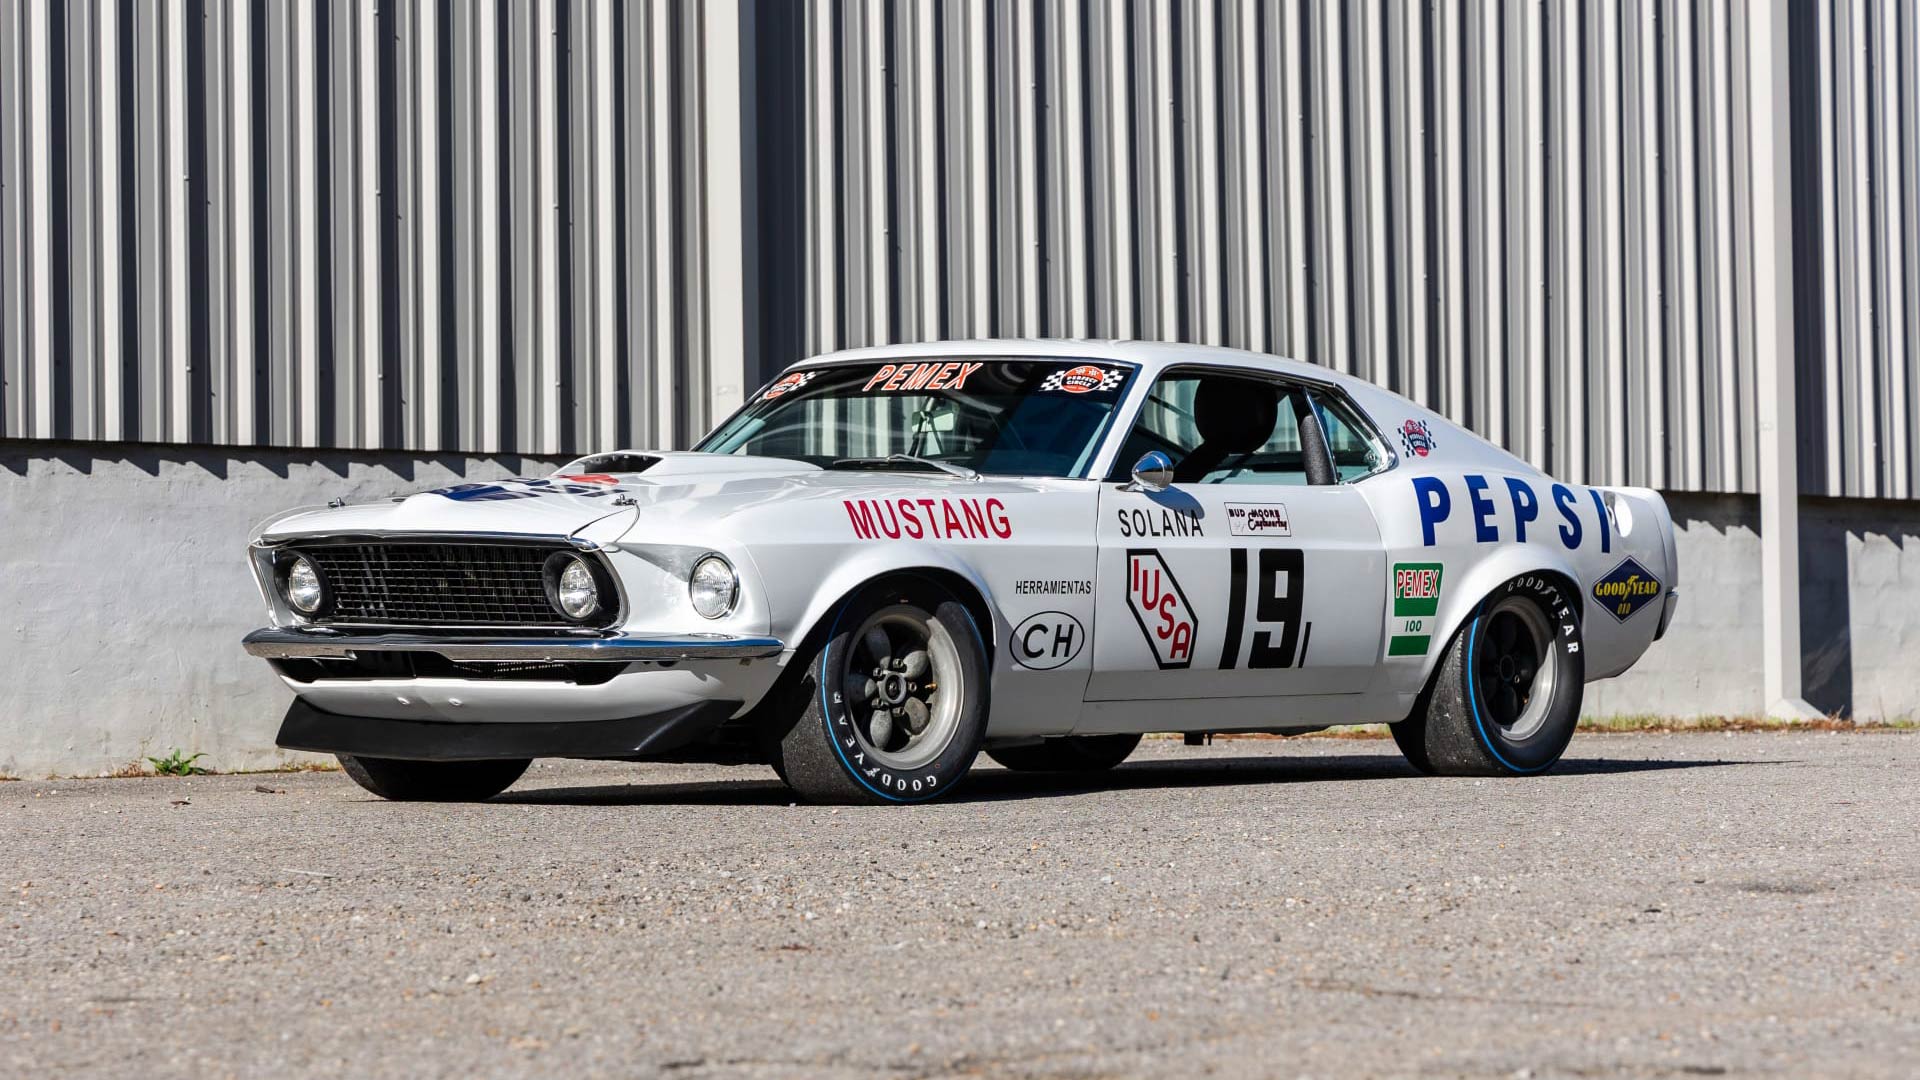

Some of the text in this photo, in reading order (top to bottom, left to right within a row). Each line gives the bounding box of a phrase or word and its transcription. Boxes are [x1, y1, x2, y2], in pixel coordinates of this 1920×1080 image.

[862, 363, 984, 392] PEMEX
[843, 498, 1012, 539] MUSTANG
[1118, 509, 1204, 537] SOLANA
[1228, 508, 1246, 518] BUD
[1411, 475, 1611, 554] PEPSI
[1015, 580, 1092, 595] HERRAMIENTAS
[1395, 570, 1440, 599] PEMEX
[1130, 559, 1191, 659] IUSA
[1218, 548, 1305, 669] 19
[1404, 620, 1422, 632] 100
[1022, 623, 1075, 659] CH
